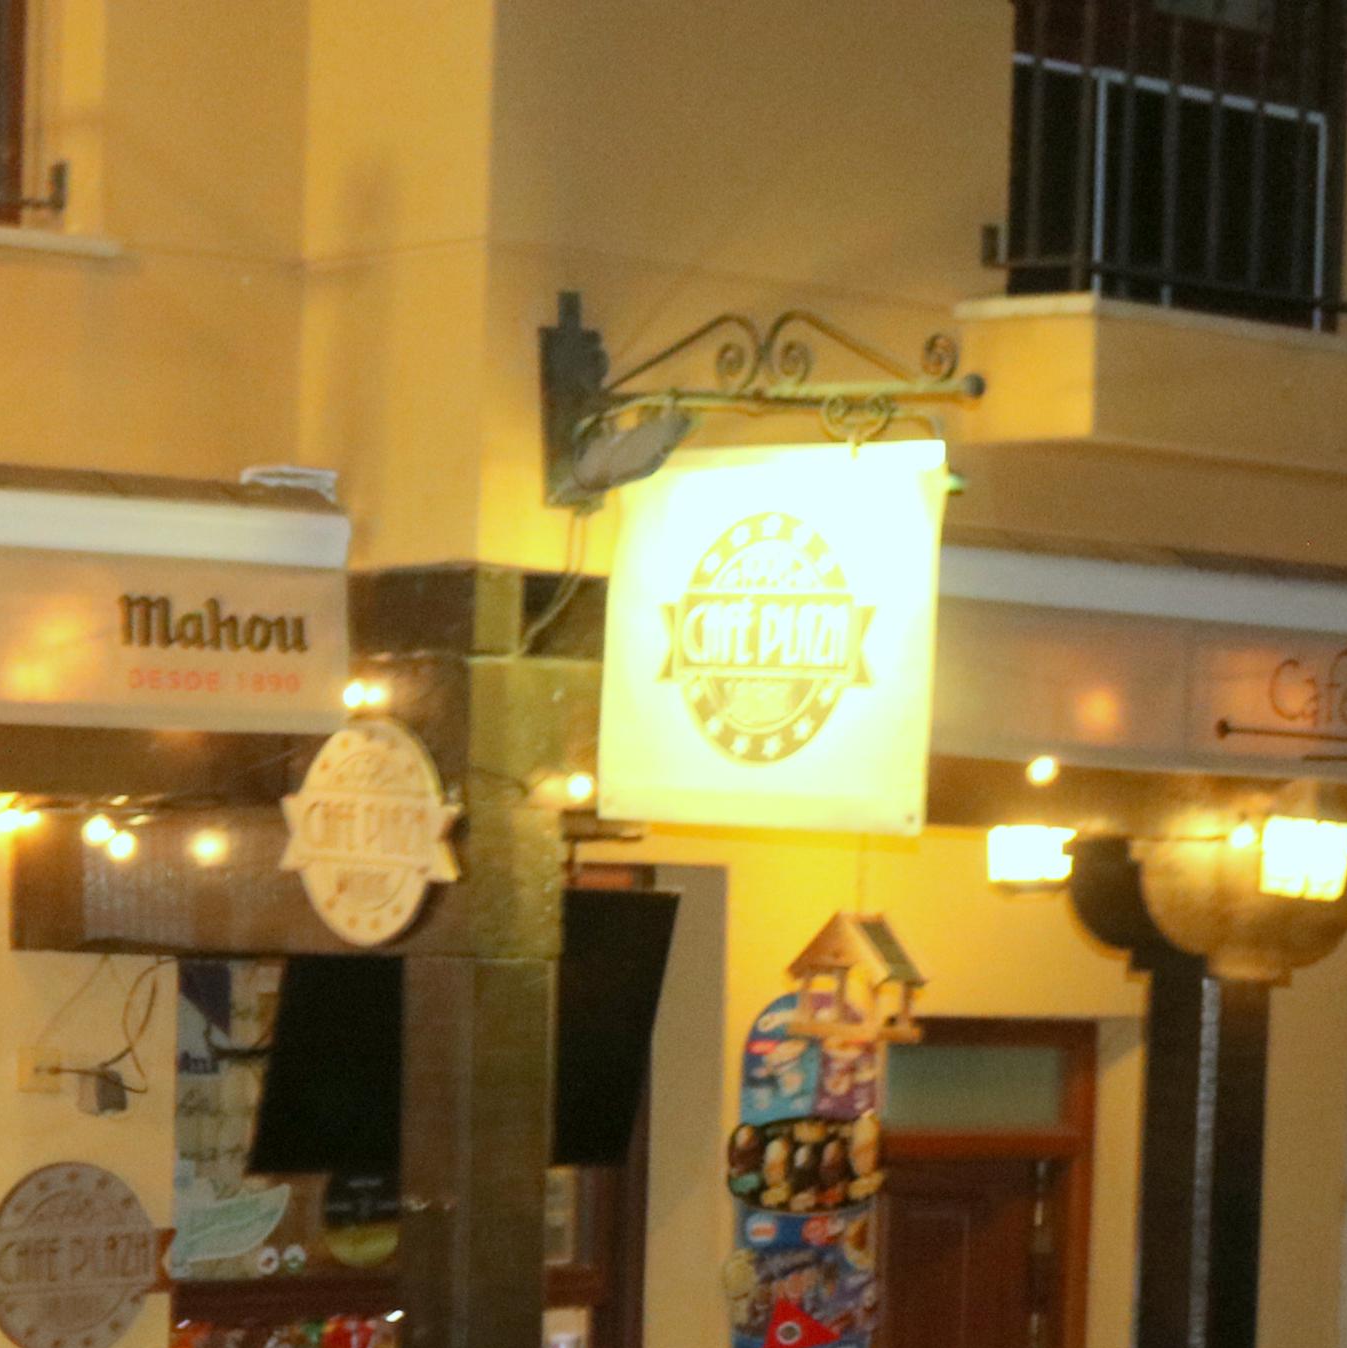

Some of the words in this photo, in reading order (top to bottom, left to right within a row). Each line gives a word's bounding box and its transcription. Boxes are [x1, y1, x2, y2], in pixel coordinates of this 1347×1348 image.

[118, 594, 308, 654] Mahou
[128, 667, 221, 692] DESDE
[237, 671, 302, 694] 1890
